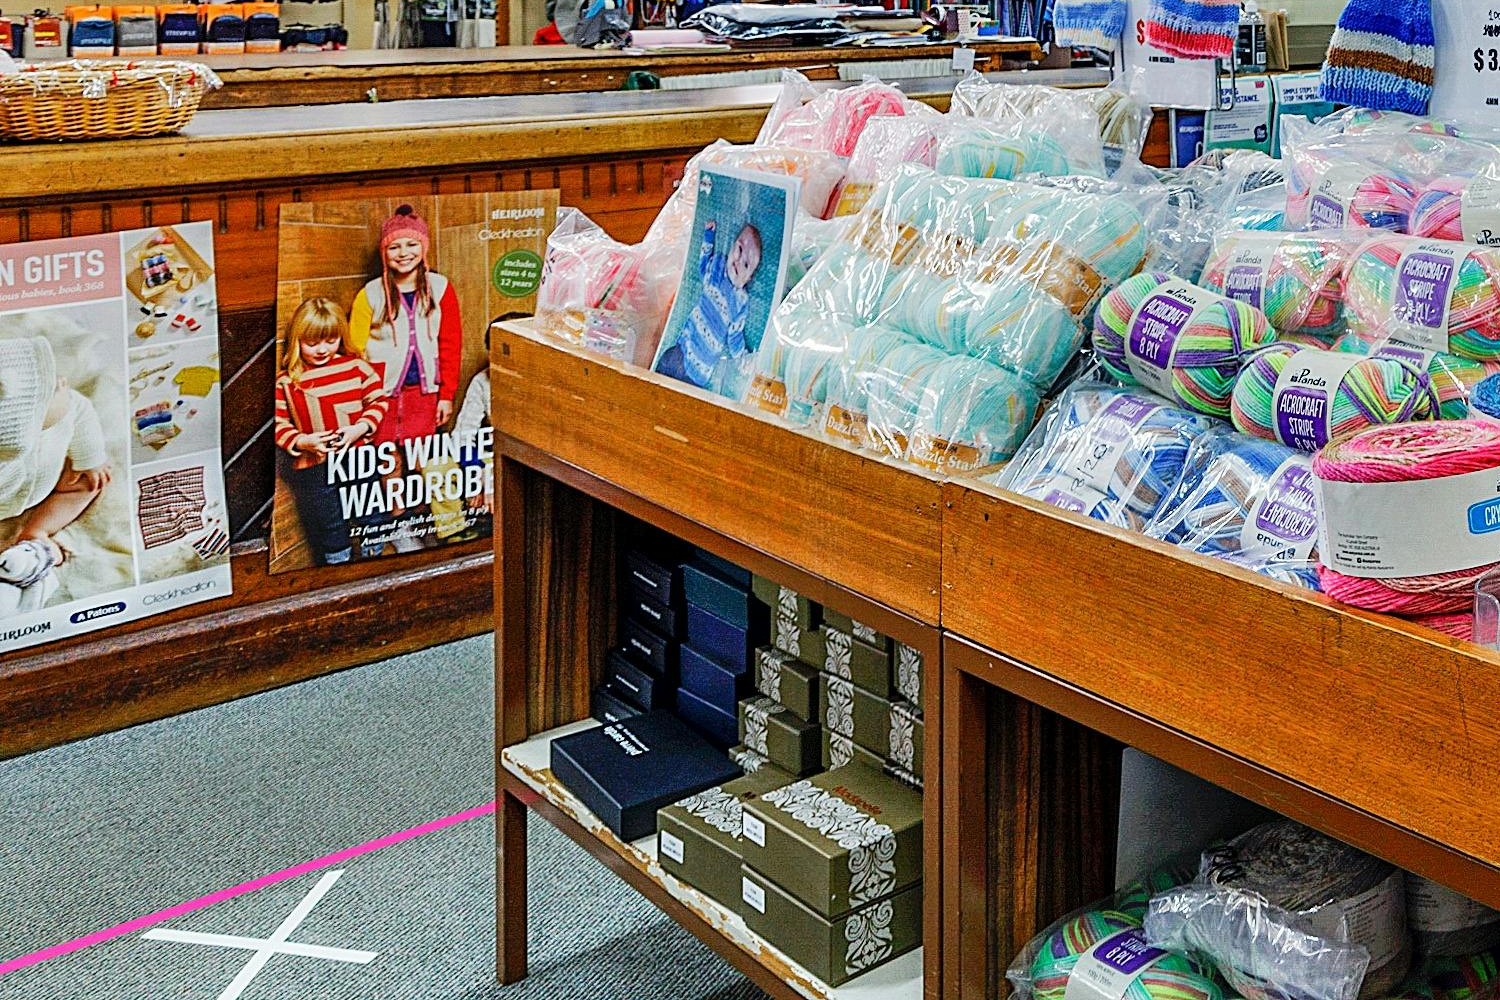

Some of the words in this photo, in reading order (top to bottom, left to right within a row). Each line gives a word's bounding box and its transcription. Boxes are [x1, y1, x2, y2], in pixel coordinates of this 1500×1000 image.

[1136, 18, 1146, 46] $
[1474, 47, 1484, 73] $
[492, 207, 545, 220] HEIRLOOM
[1311, 200, 1344, 224] ACROCRAFT
[24, 249, 105, 284] GIFTS
[503, 259, 537, 268] includes
[528, 270, 536, 278] to
[1404, 257, 1452, 280] ACROCRAFT
[58, 283, 83, 295] book
[501, 278, 511, 286] 12
[511, 280, 533, 288] years
[1407, 281, 1435, 301] STRIPE
[1171, 287, 1197, 306] Panda
[1143, 298, 1188, 327] ACROCRAFT
[1141, 317, 1168, 343] STRIPE
[1138, 337, 1147, 354] 8
[1145, 339, 1161, 361] PLY
[1297, 368, 1327, 388] Panda
[1278, 393, 1326, 419] ACROCRAFT
[1287, 416, 1316, 439] STRIPE
[327, 441, 397, 485] KIDS
[404, 426, 494, 472] WINTE
[349, 527, 362, 538] 12
[363, 524, 379, 537] fun
[379, 520, 397, 532] and
[398, 515, 425, 528] stylish
[86, 603, 121, 619] Patons
[142, 579, 217, 607] Cleckheaton
[1105, 946, 1121, 959] 8
